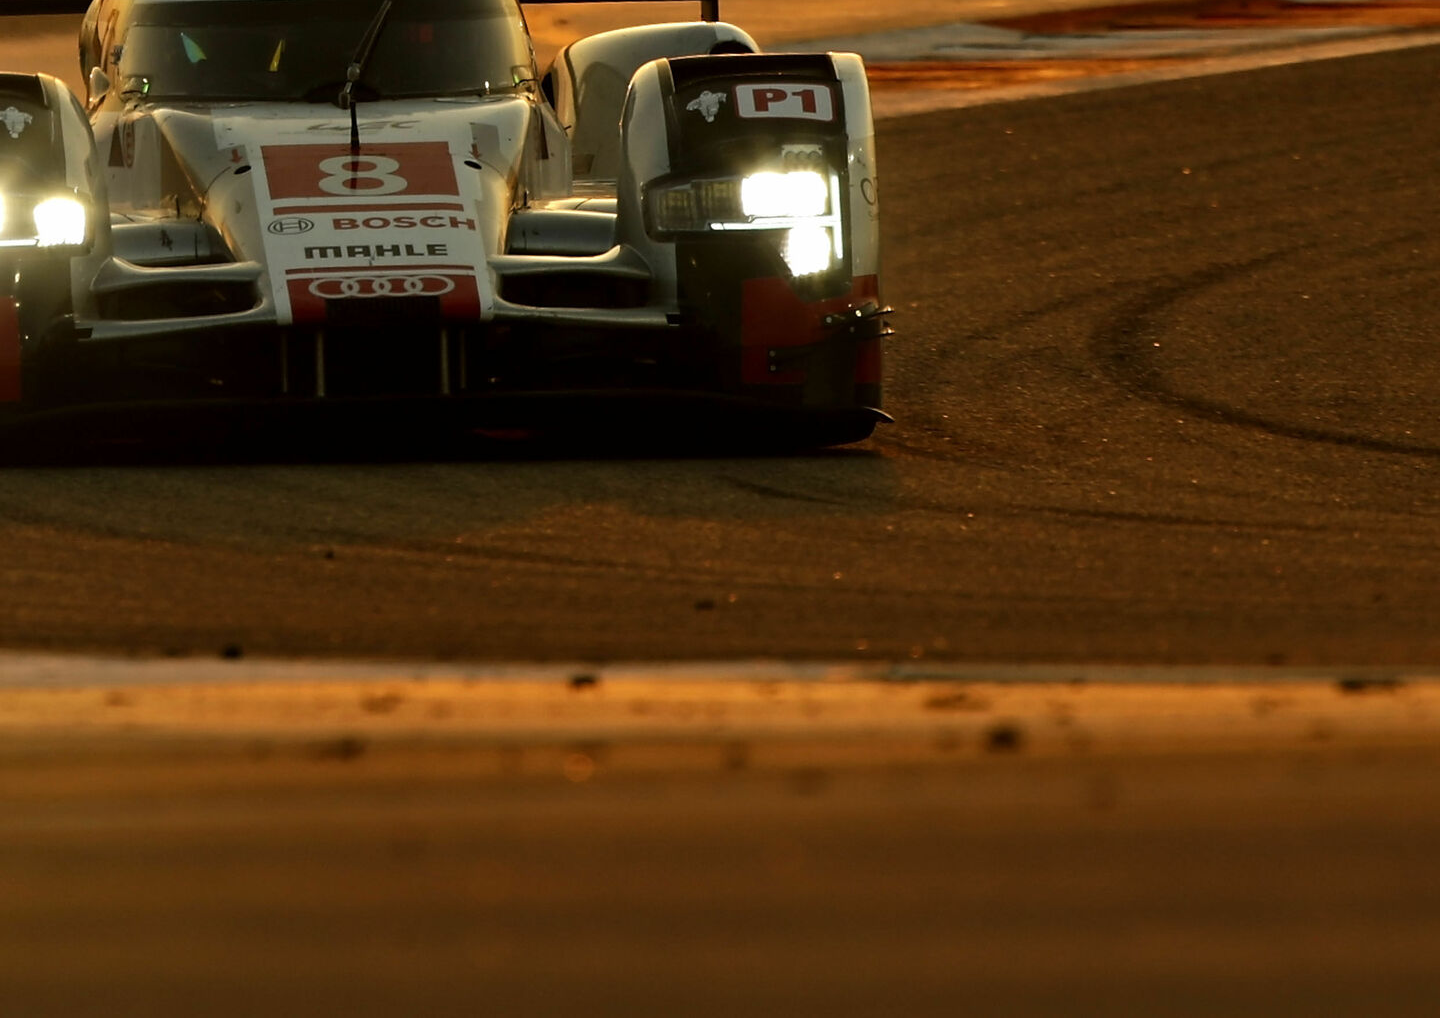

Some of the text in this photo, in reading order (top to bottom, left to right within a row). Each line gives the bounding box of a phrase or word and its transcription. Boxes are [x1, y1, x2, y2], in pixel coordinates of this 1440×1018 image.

[752, 88, 817, 113] P1
[318, 155, 408, 196] 8
[332, 216, 476, 231] BOSCH
[304, 243, 448, 259] MAHLE
